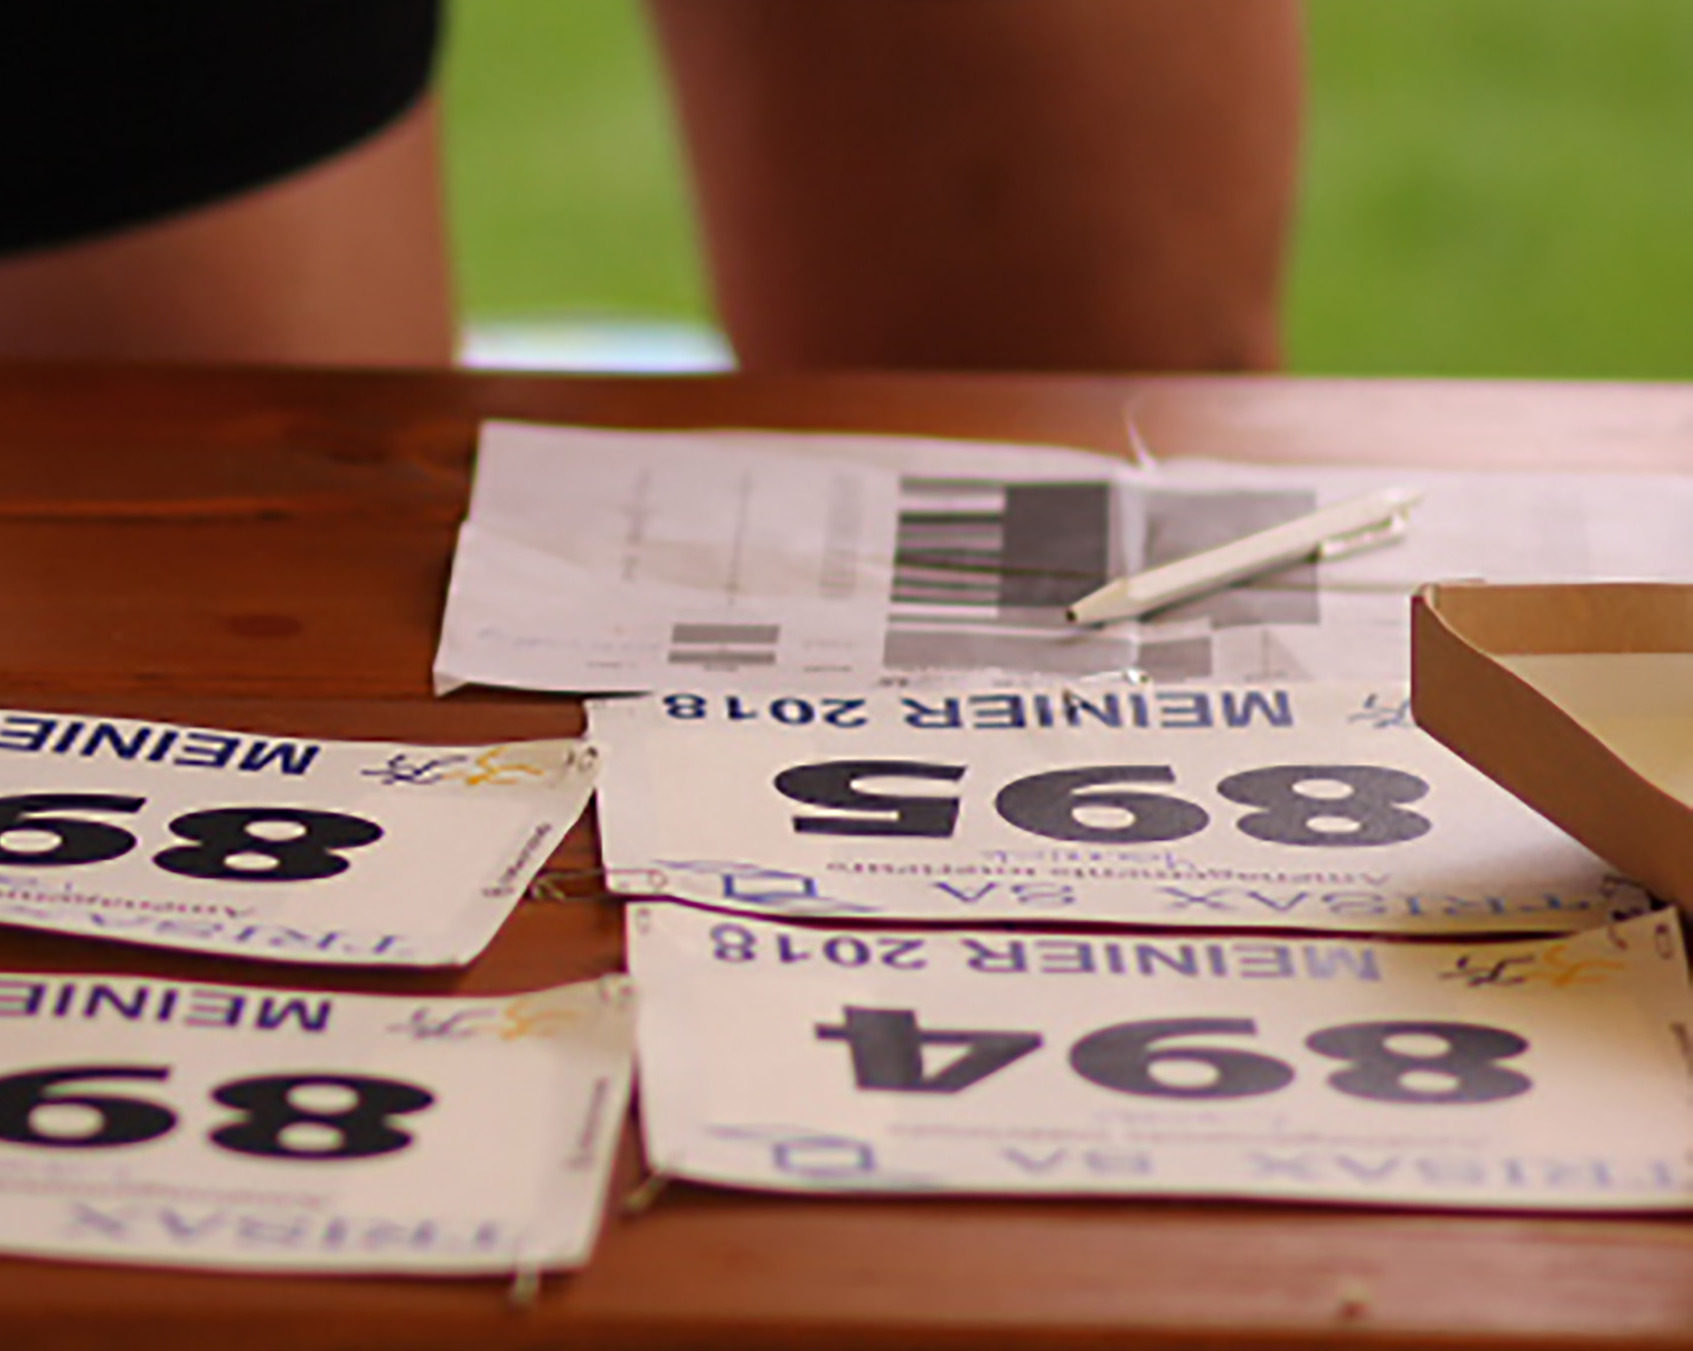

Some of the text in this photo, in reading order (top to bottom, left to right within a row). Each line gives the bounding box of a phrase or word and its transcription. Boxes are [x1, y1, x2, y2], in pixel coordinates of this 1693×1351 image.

[662, 691, 1292, 729] MEINIER 2018
[773, 760, 1432, 848] 895
[932, 881, 1588, 917] TRISAX SA
[709, 925, 1383, 983] MEINIER 2018
[815, 1005, 1534, 1105] 894
